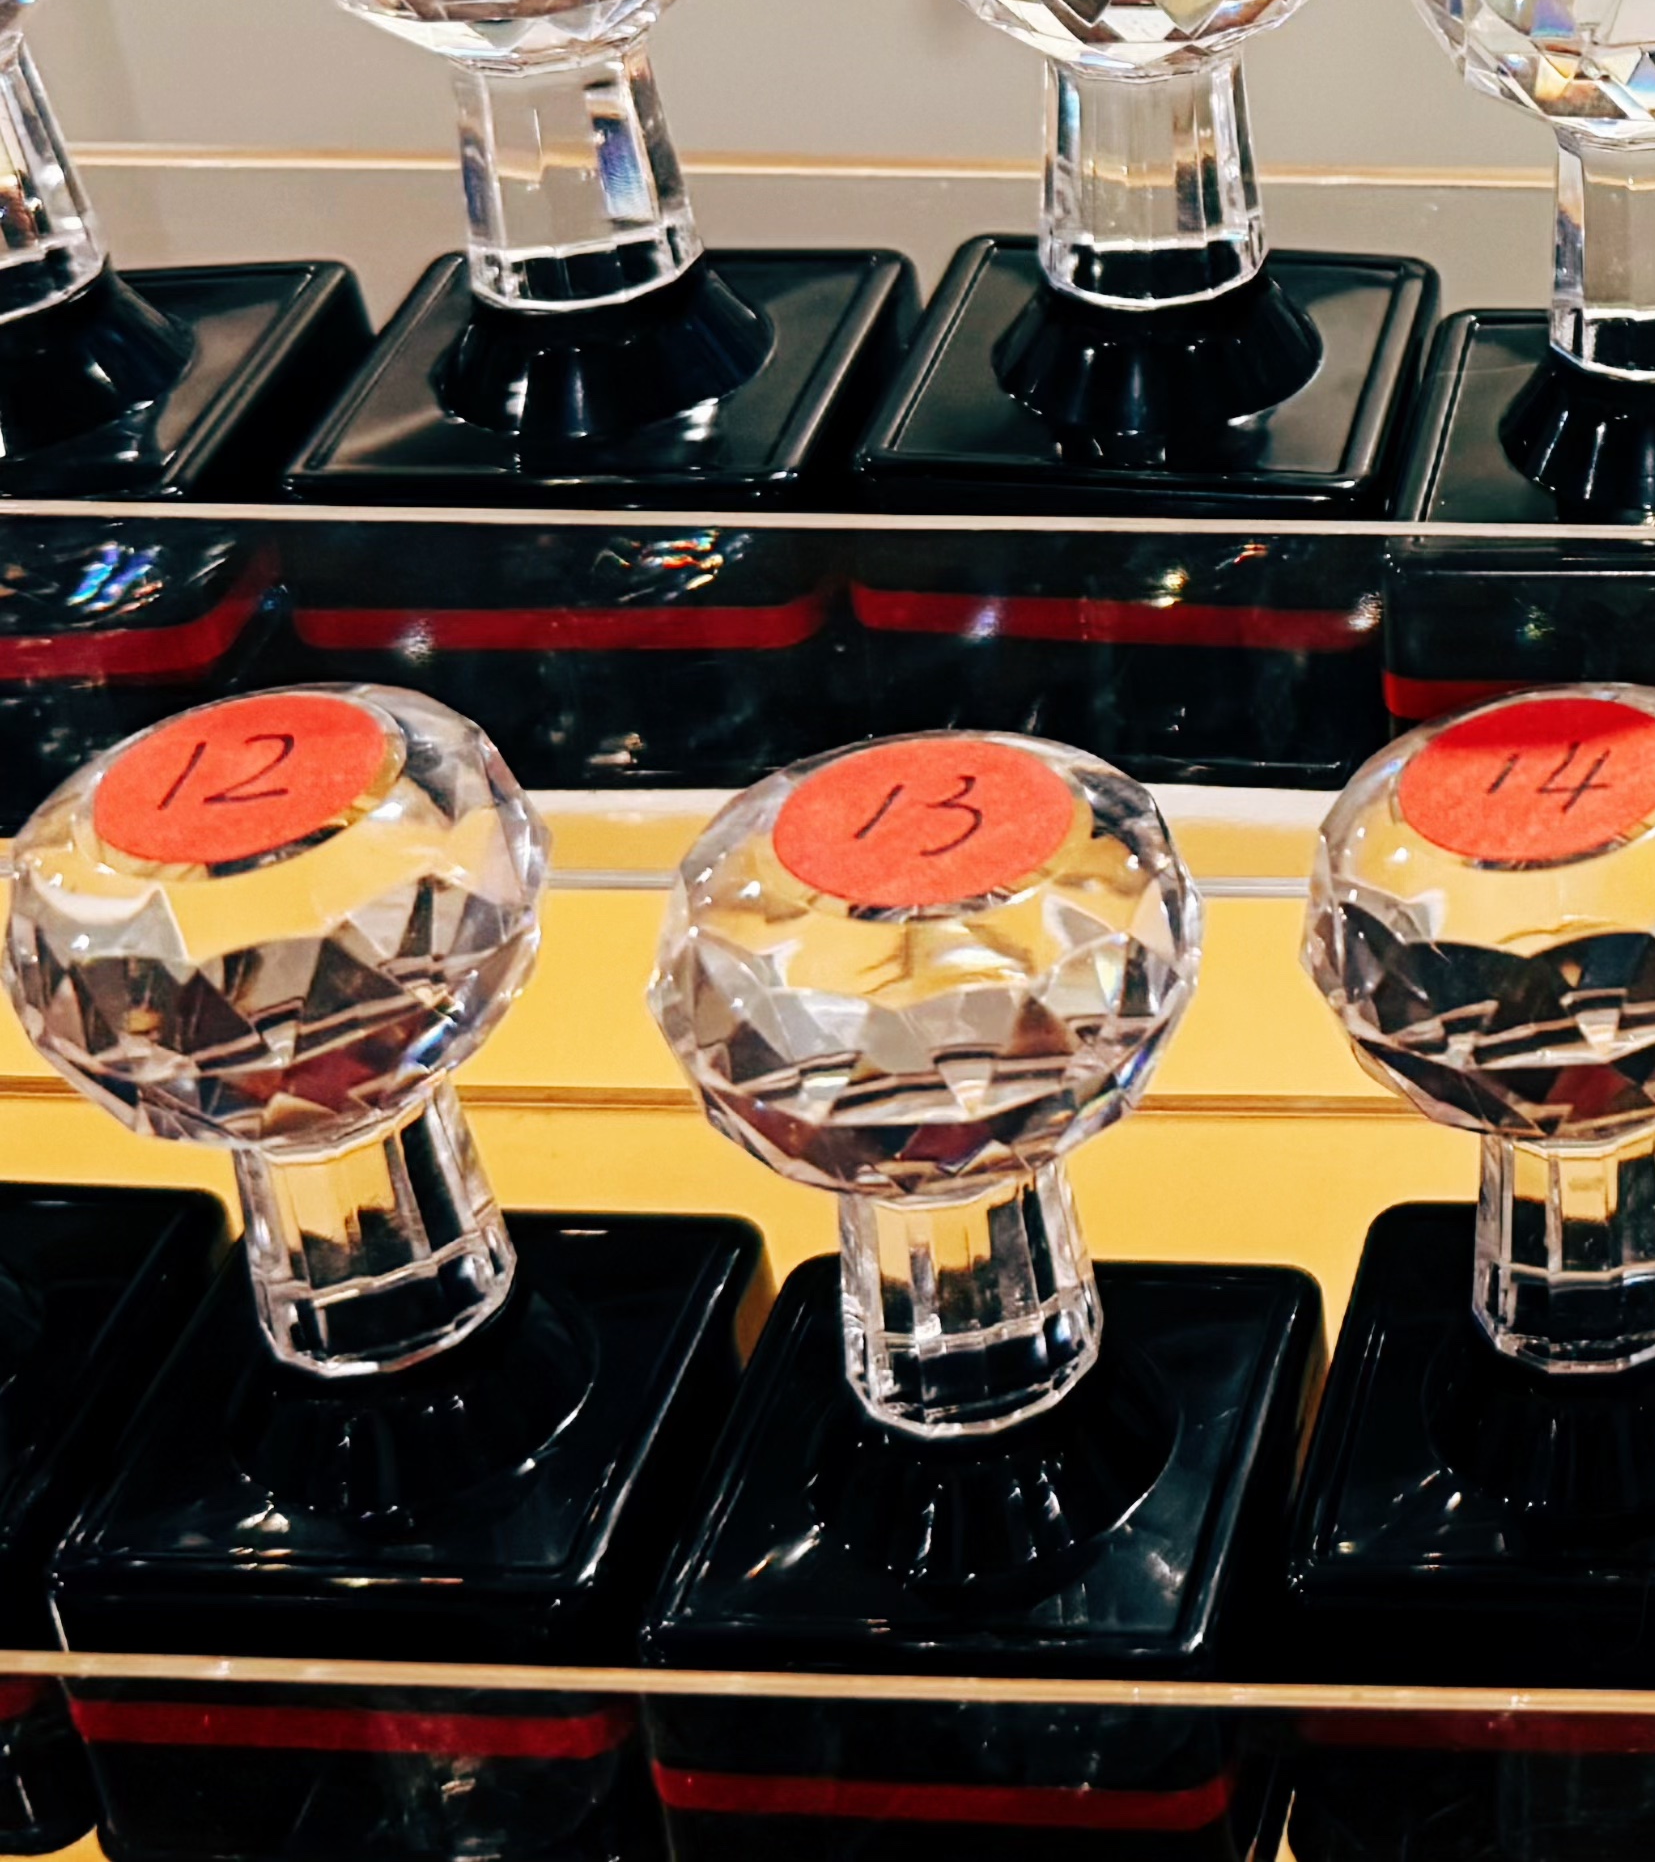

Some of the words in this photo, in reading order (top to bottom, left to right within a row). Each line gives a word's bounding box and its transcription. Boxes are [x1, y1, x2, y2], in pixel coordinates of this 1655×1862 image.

[156, 732, 296, 812] 12
[1488, 740, 1613, 815] 14
[852, 774, 984, 858] 13
